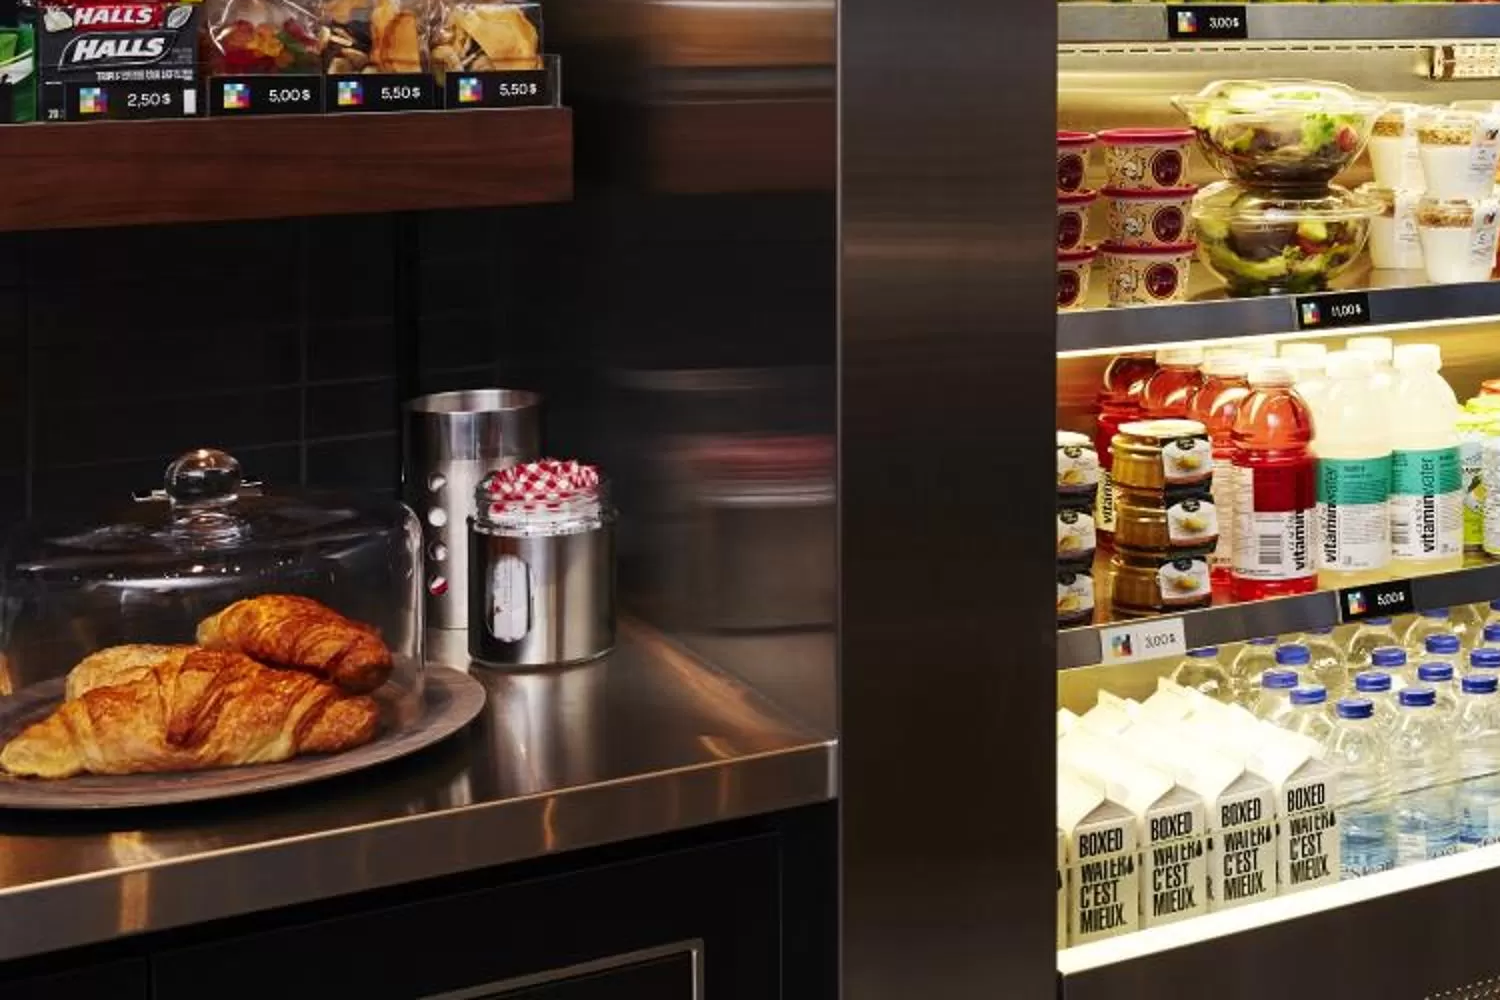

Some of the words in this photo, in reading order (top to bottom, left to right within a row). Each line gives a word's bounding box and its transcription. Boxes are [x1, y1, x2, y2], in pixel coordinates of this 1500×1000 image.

[73, 6, 153, 26] HALLS
[71, 37, 166, 63] HALLS
[127, 92, 172, 108] 2,50$
[268, 87, 311, 103] 5,00$
[380, 85, 421, 100] 5,50$
[499, 81, 538, 96] 5,50$
[1287, 783, 1326, 813] BOXED
[1151, 811, 1193, 841] BOXED
[1221, 797, 1262, 828] BOXED
[1079, 827, 1123, 859] BOXED
[1289, 833, 1324, 861] C'EST
[1223, 848, 1260, 877] C'EST
[1153, 863, 1191, 892] C'EST
[1080, 881, 1118, 909] C'EST
